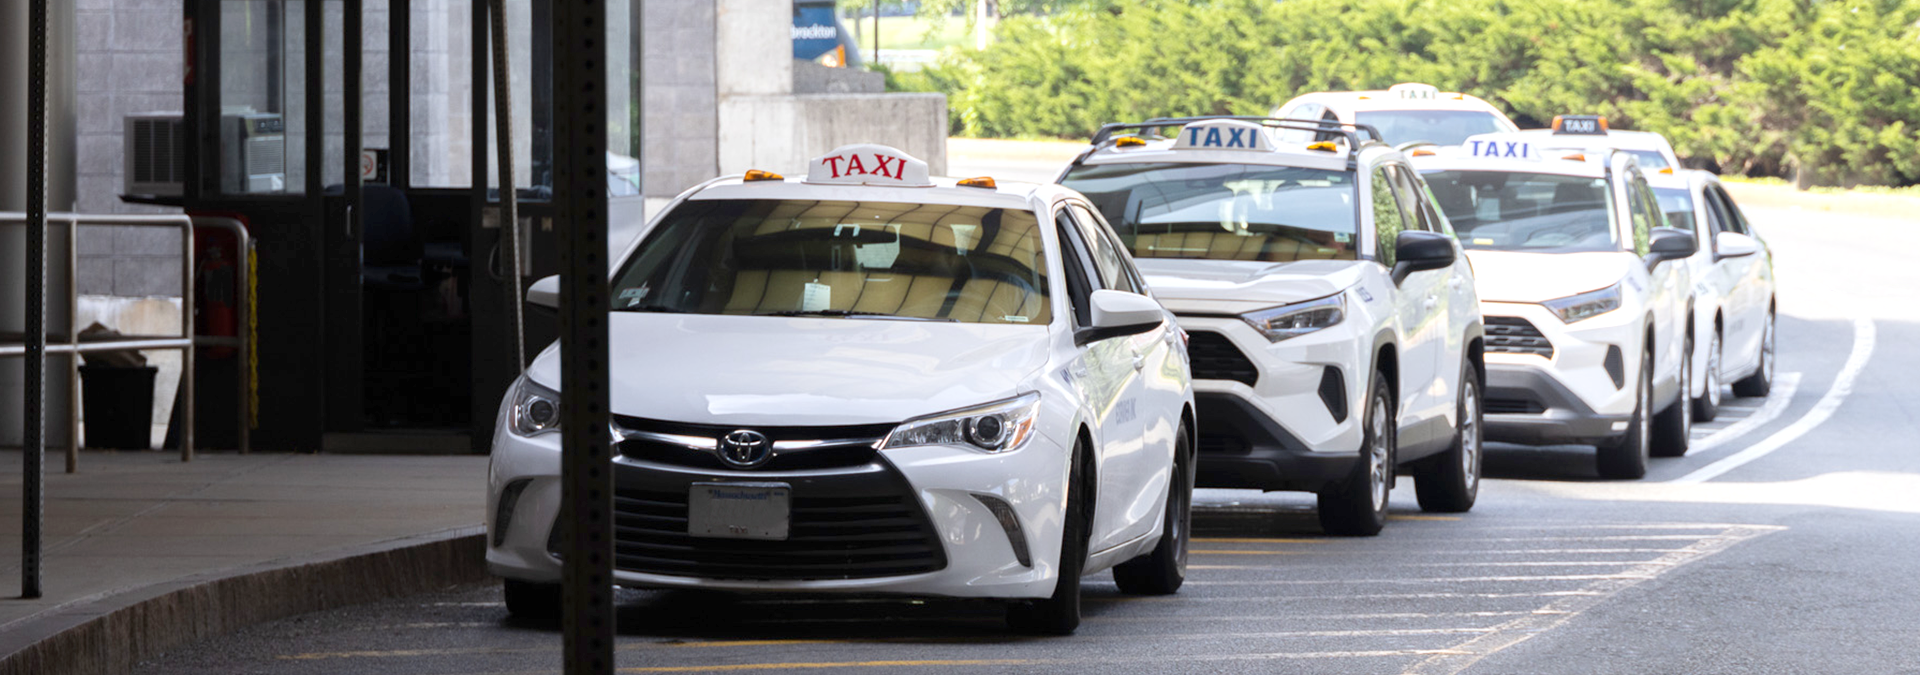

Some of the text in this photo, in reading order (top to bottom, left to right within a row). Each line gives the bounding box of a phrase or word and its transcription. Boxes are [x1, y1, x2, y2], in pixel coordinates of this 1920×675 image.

[1400, 90, 1436, 99] TAXI
[1564, 119, 1595, 132] TAXI
[1185, 126, 1257, 148] TAXI
[1470, 140, 1528, 158] TAXI
[822, 153, 907, 181] TAXI
